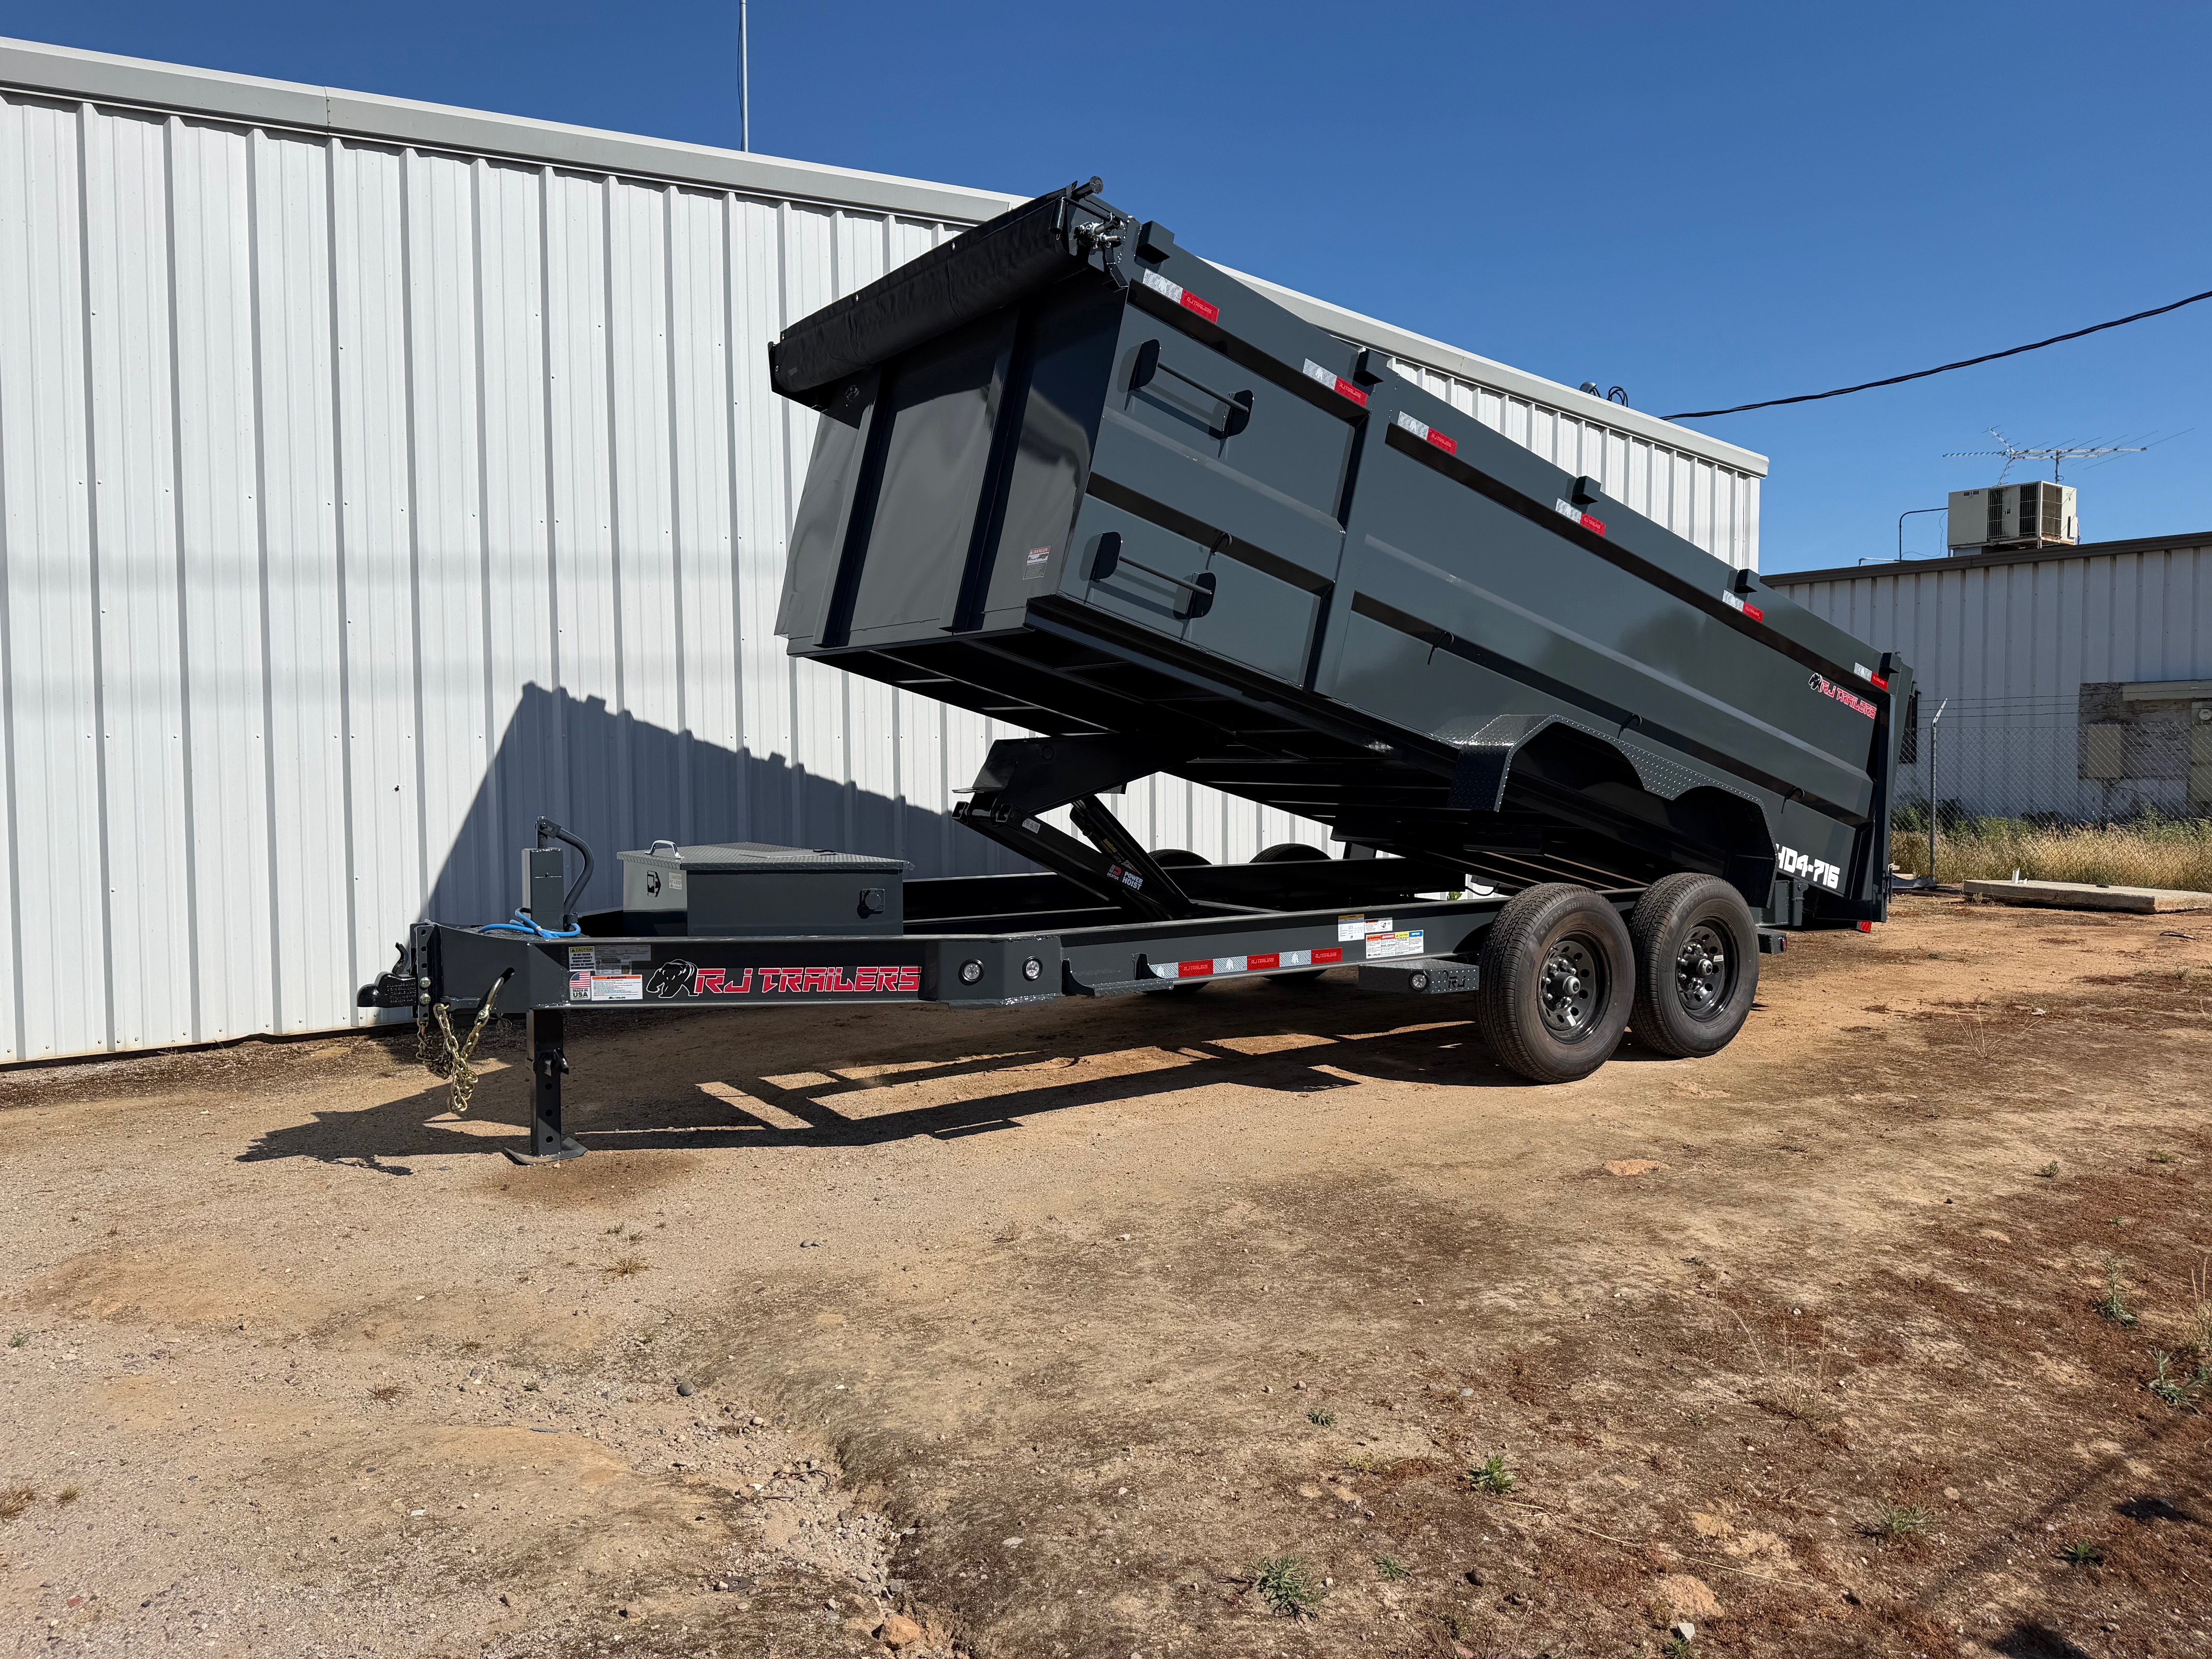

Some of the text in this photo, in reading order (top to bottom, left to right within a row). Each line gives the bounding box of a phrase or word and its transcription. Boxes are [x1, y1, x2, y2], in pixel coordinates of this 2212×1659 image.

[1820, 679, 1877, 719] RJ TRAILERS
[1122, 876, 1142, 890] HOIST
[1124, 871, 1143, 884] POWER
[694, 965, 922, 994] RJ TRAILERS
[1448, 975, 1466, 988] RJ
